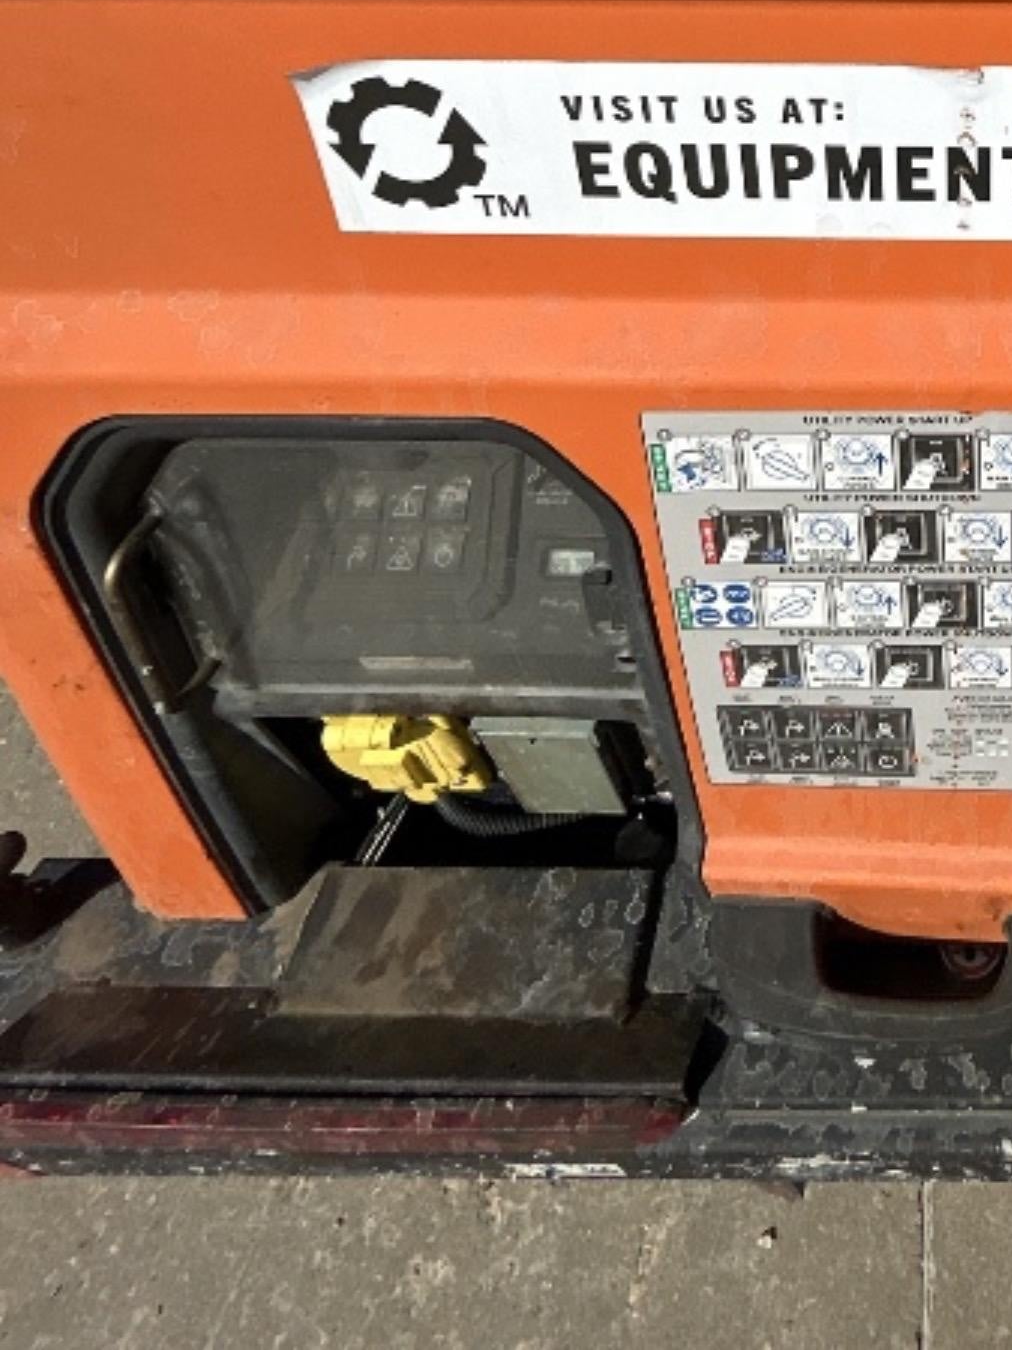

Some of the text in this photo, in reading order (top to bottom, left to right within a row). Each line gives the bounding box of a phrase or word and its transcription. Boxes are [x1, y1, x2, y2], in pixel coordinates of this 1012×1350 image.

[560, 94, 845, 125] VISIT US AT:
[473, 193, 531, 218] TM
